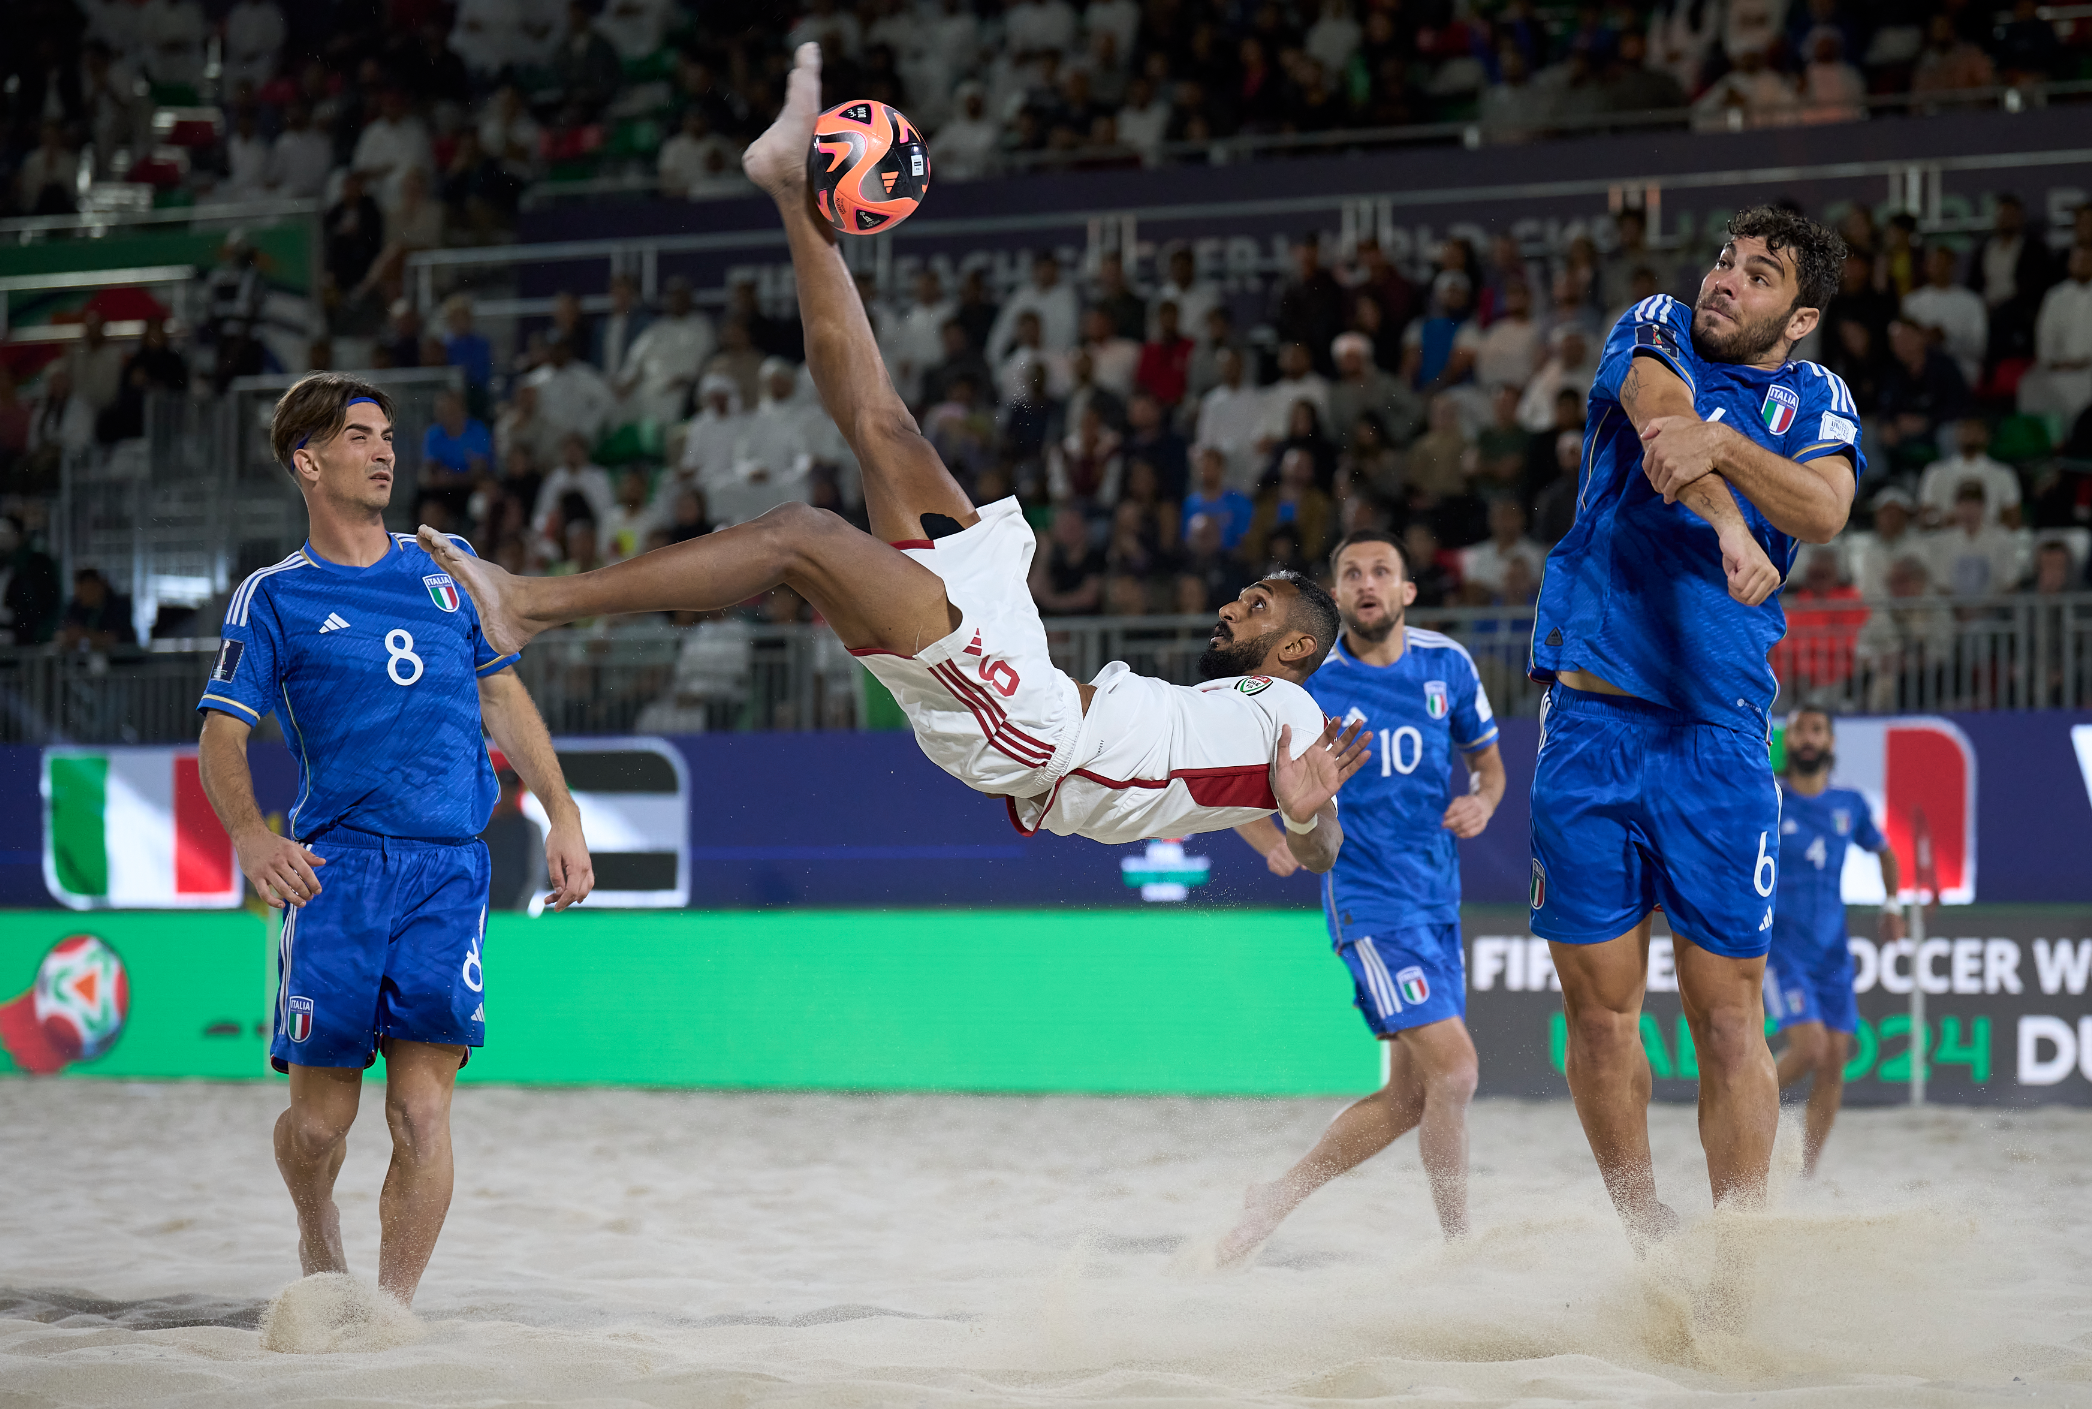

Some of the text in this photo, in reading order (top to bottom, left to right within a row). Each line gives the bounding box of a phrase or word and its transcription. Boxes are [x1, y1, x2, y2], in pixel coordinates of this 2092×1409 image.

[1770, 388, 1796, 406] ITALIA
[424, 576, 451, 586] ITALIA
[384, 628, 424, 686] 8
[1379, 725, 1423, 777] 10
[1753, 830, 1775, 898] 6
[1805, 836, 1827, 870] 4
[1847, 937, 2024, 995] OCCER
[290, 1000, 311, 1012] ITALIA
